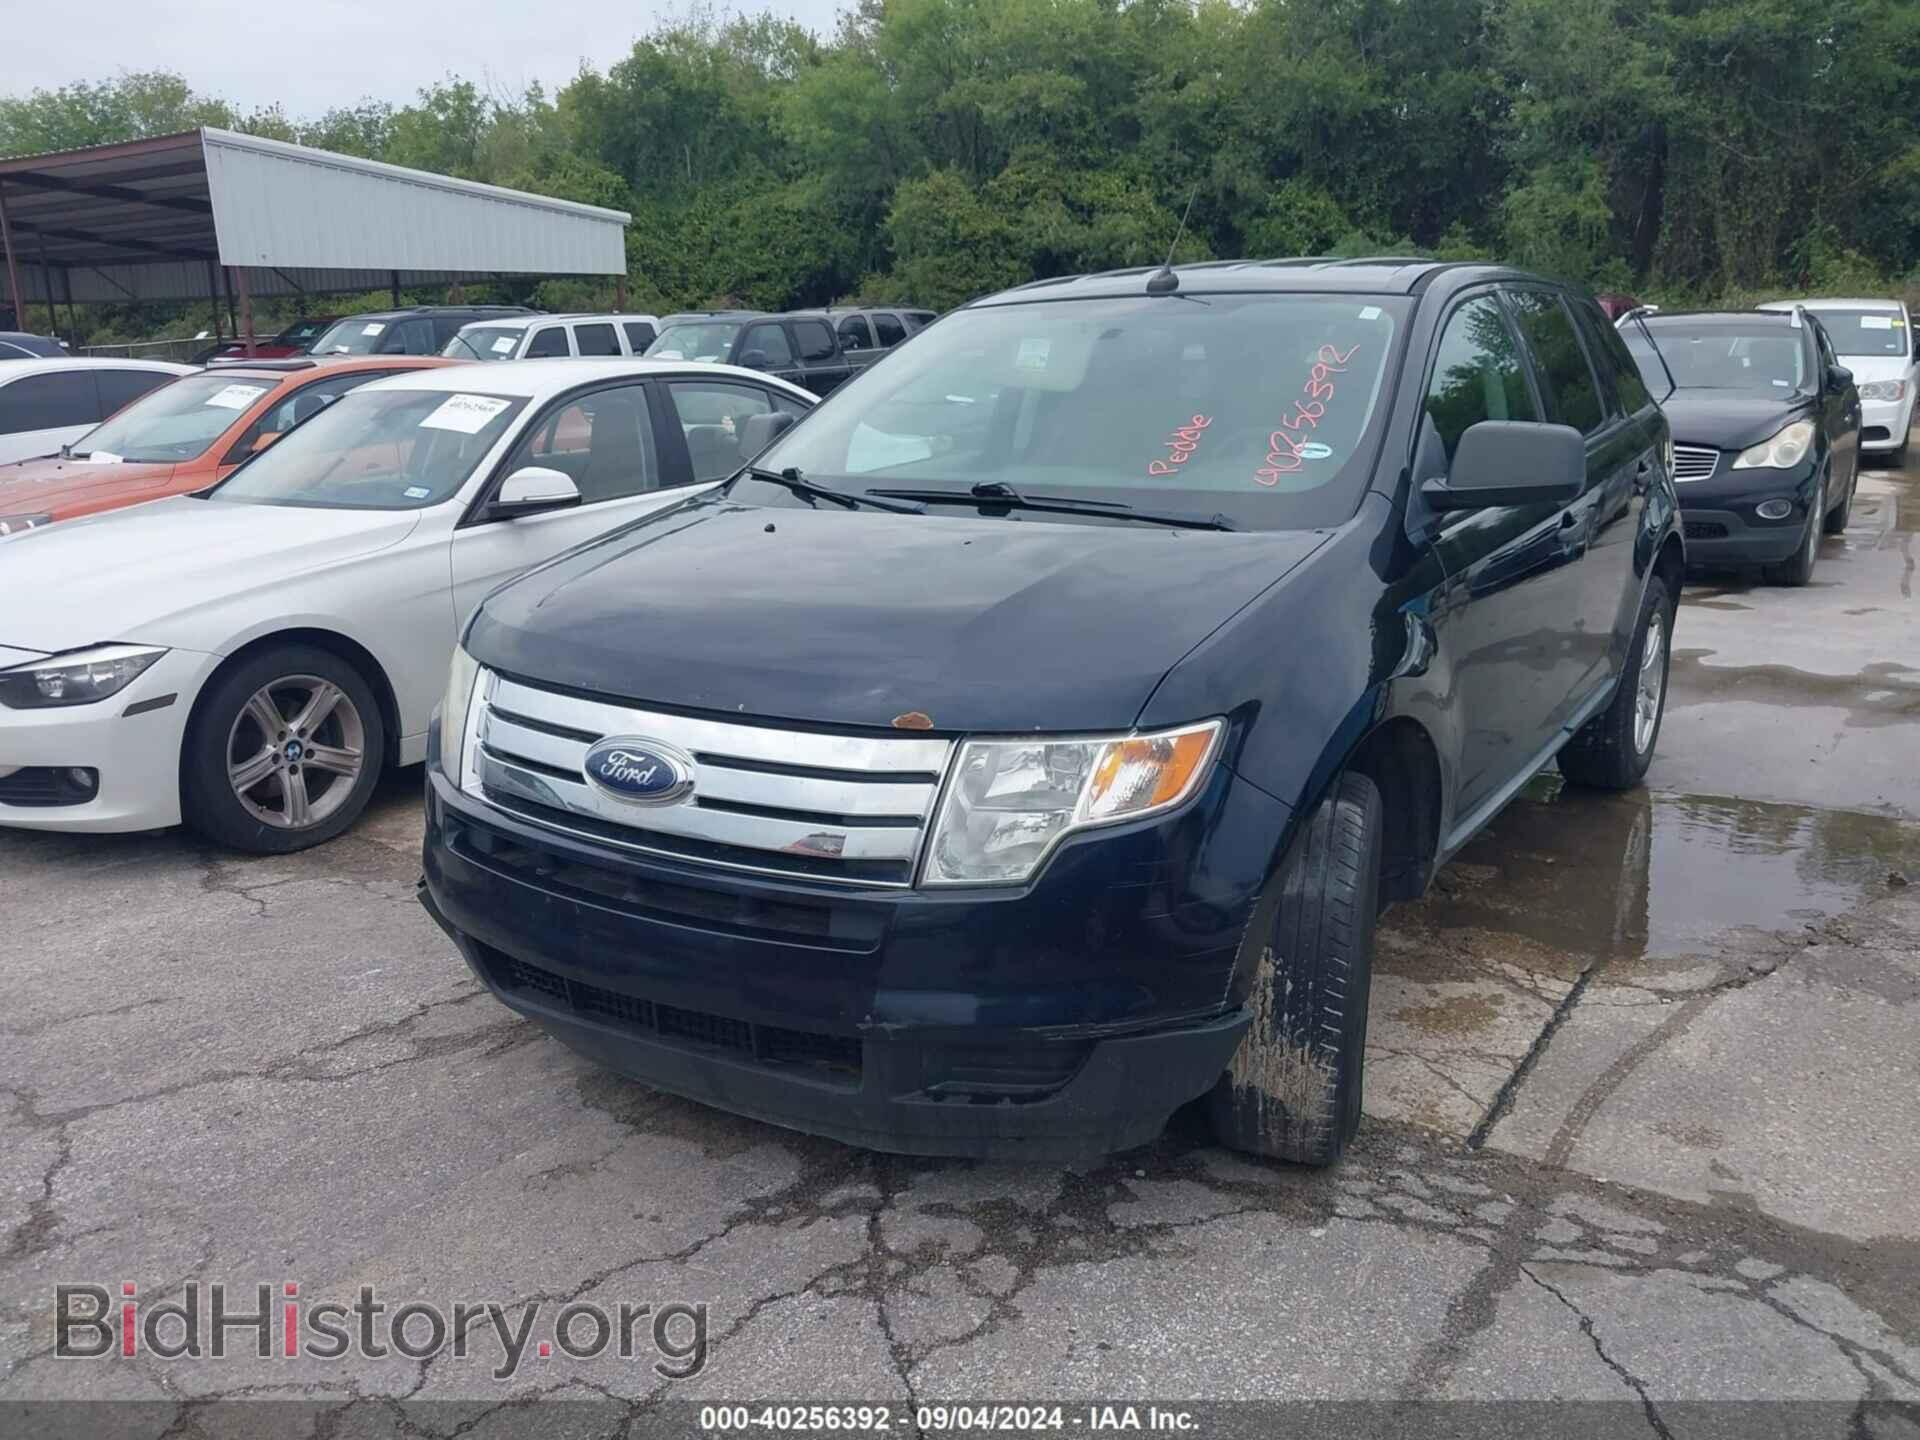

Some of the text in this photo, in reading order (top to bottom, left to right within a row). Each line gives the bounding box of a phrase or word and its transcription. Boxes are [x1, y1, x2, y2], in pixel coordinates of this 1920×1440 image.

[1149, 414, 1213, 475] Peddle
[1254, 344, 1361, 485] 40256392
[600, 750, 657, 786] Ford
